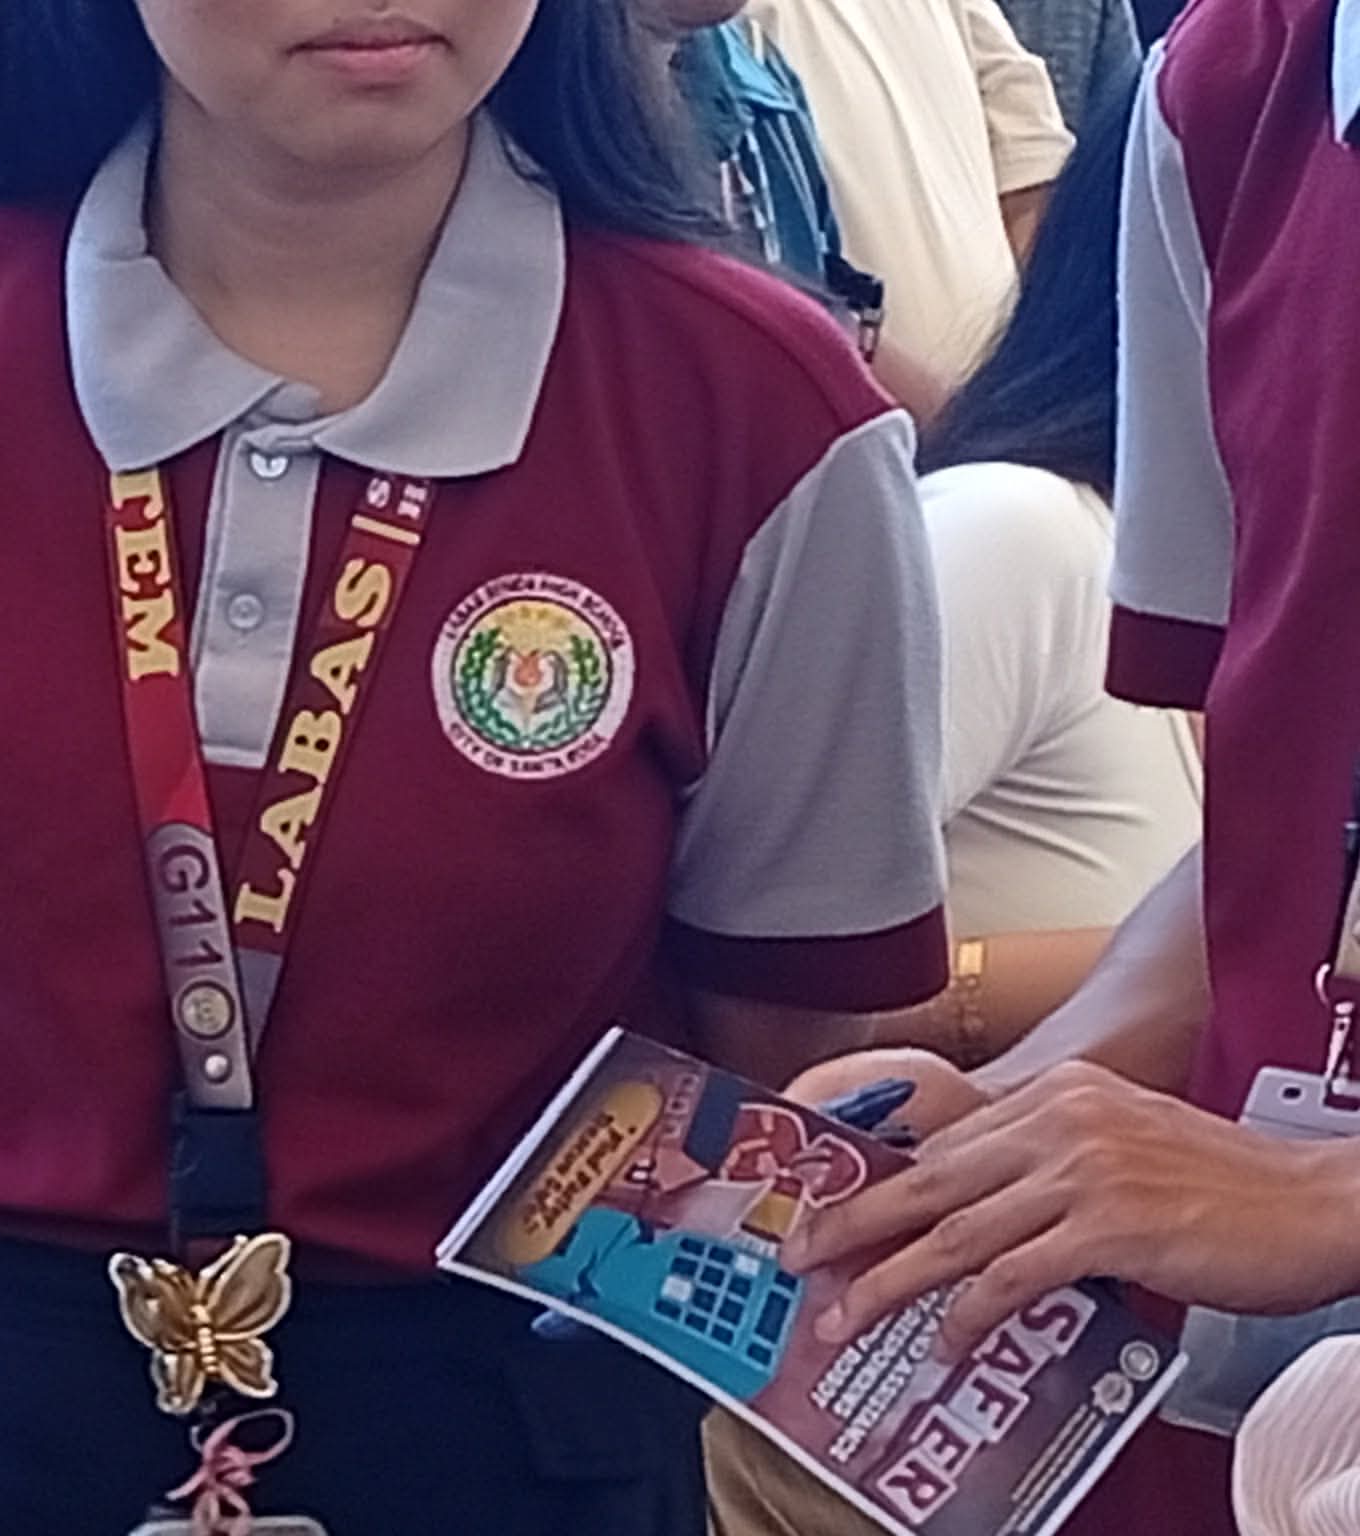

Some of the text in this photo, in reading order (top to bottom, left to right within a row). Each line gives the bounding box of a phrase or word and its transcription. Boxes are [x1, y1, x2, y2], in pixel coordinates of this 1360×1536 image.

[235, 557, 392, 933] LABAS
[157, 844, 224, 970] G11
[883, 1300, 1083, 1514] SAFER
